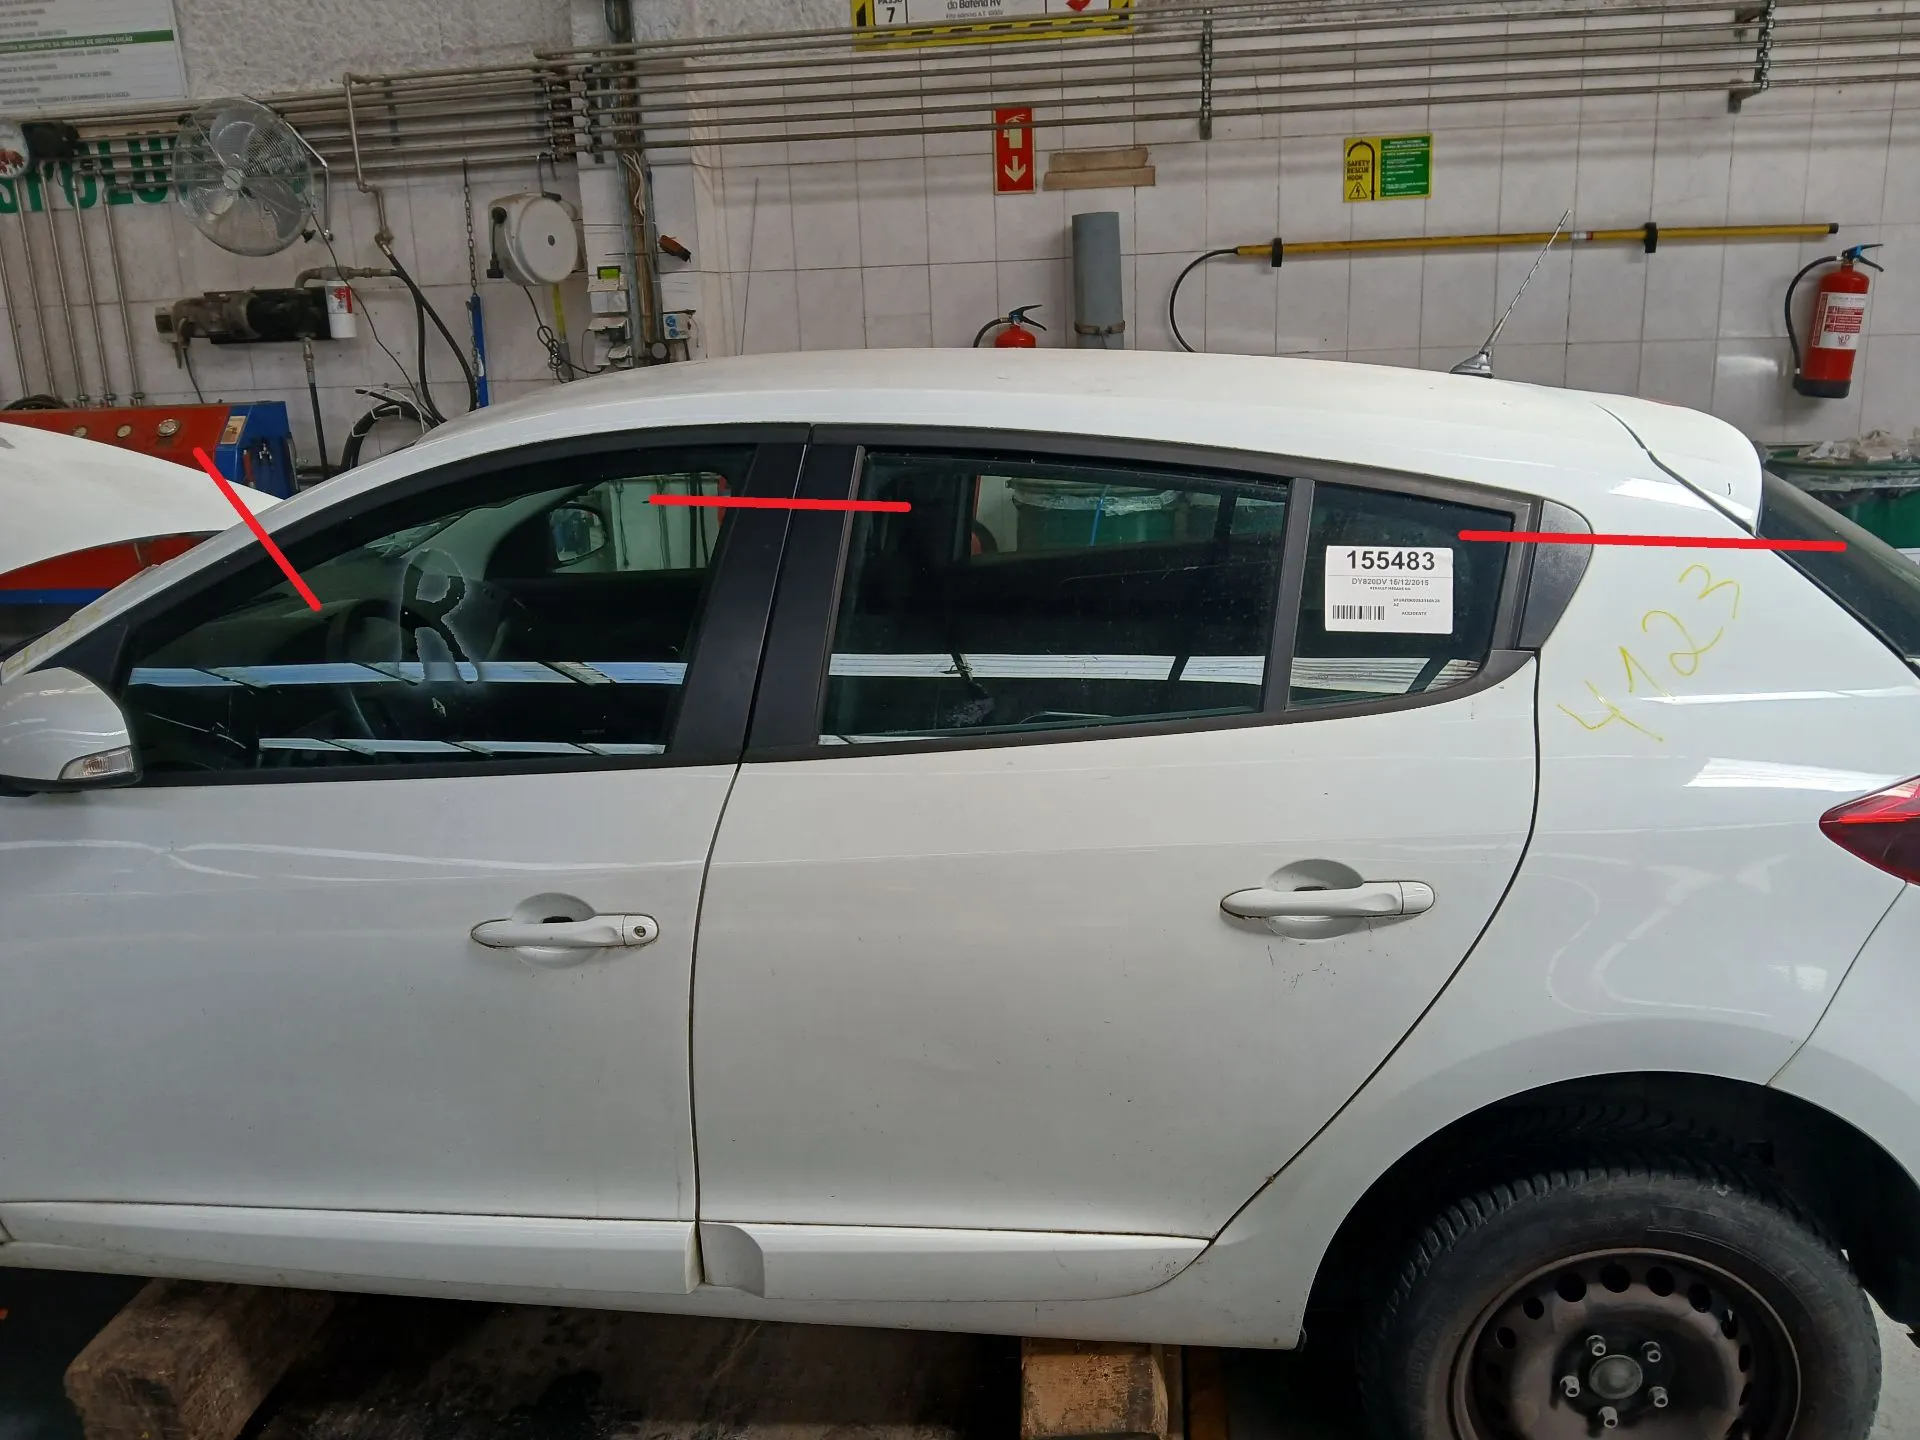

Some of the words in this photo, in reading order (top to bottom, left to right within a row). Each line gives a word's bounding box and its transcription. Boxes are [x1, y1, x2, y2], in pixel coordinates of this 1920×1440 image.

[886, 7, 895, 23] 7
[1346, 550, 1435, 571] 155483
[1351, 577, 1387, 585] DY820DV
[1557, 564, 1740, 742] 4123
